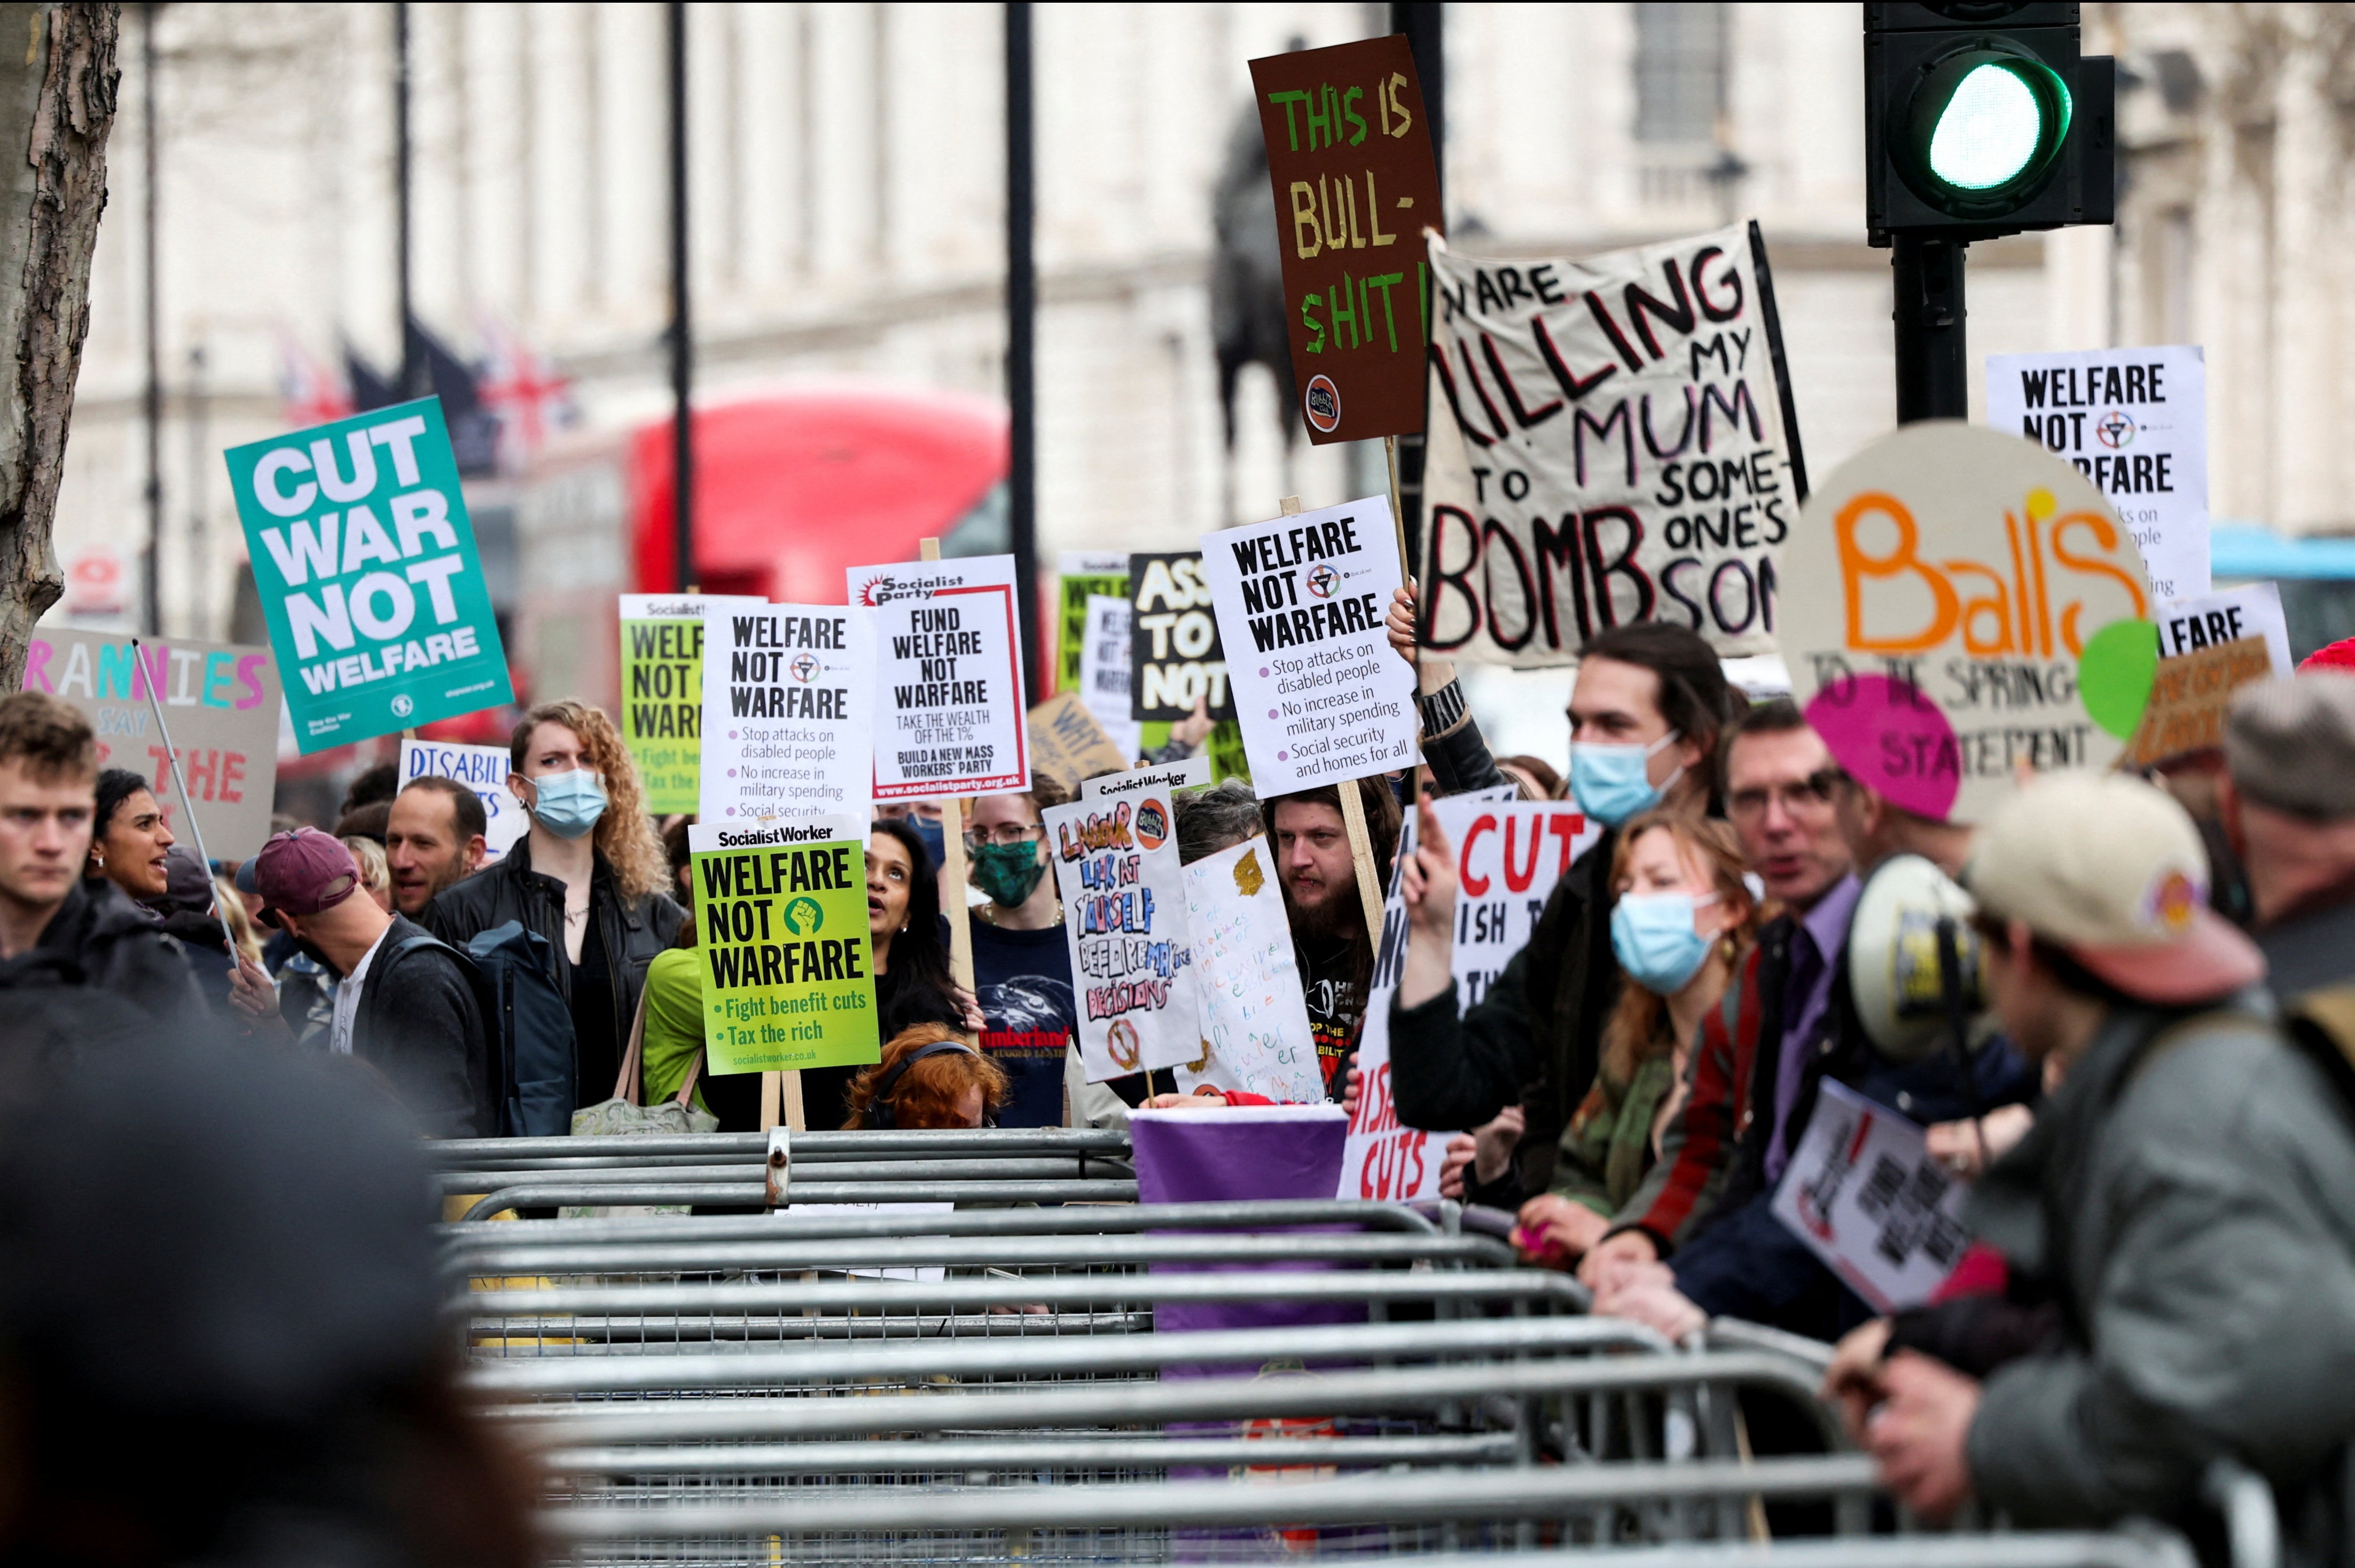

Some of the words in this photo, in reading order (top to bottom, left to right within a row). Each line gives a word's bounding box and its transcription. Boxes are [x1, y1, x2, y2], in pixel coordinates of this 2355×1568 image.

[1268, 82, 1367, 152] THIS
[1378, 72, 1412, 138] IS
[1290, 169, 1414, 260] BULL-
[1476, 265, 1565, 315] ARE
[1301, 270, 1403, 354] SHIT
[1690, 327, 1751, 381] MY
[2021, 364, 2165, 409] WELFARE
[1574, 379, 1763, 488] MUM
[2023, 412, 2087, 452] NOT
[253, 415, 426, 518] CUT
[1472, 467, 1529, 504] TO
[1664, 499, 1788, 550] ONE'S
[2138, 509, 2158, 523] on
[259, 490, 459, 587] WAR
[1231, 517, 1362, 576] WELFARE
[881, 576, 964, 592] Socialist
[1241, 570, 1298, 615] NOT
[1418, 504, 1655, 652] BOMB
[284, 554, 465, 661] NOT
[911, 607, 960, 633] FUND
[1248, 593, 1383, 653] WARFARE
[732, 616, 846, 649] WELFARE
[893, 631, 982, 660] WELFARE
[1139, 610, 1214, 660] TO
[300, 626, 480, 695] WELFARE
[731, 652, 784, 683] NOT
[921, 657, 957, 683] NOT
[1272, 656, 1303, 676] Stop
[1306, 646, 1354, 668] attacks
[1357, 644, 1374, 656] on
[1278, 671, 1333, 695] disabled
[1336, 660, 1381, 687] people
[633, 665, 690, 699] NOT
[894, 680, 988, 709] WARFARE
[1143, 660, 1229, 711] NOT
[730, 687, 848, 719] WARFARE
[1282, 701, 1302, 718] No
[1305, 692, 1359, 712] increase
[1362, 686, 1374, 699] in
[1287, 714, 1335, 736] military
[1340, 701, 1401, 727] spending
[97, 708, 149, 737] SAY
[632, 704, 701, 739] WAR
[742, 727, 769, 743] Stop
[772, 728, 816, 742] attacks
[818, 732, 834, 742] on
[897, 715, 924, 730] TAKE
[926, 712, 945, 727] THE
[946, 710, 990, 726] WEALTH
[914, 729, 934, 744] OFF
[935, 727, 954, 742] THE
[957, 726, 974, 741] 1%
[741, 744, 791, 759] disabled
[795, 745, 835, 762] people
[898, 749, 928, 764] BUILD
[930, 749, 937, 762] A
[939, 748, 962, 761] NEW
[966, 745, 993, 759] MASS
[1291, 737, 1332, 759] Social
[1334, 728, 1385, 750] security
[1296, 762, 1321, 778] and
[1323, 753, 1368, 772] homes
[1370, 747, 1389, 762] for
[1392, 740, 1408, 756] all
[148, 745, 246, 803] THE
[741, 766, 758, 779] No
[761, 766, 810, 780] increase
[813, 768, 825, 780] in
[877, 775, 1020, 796] www.socialistparty.org.uk
[902, 762, 957, 778] WORKERS'
[959, 759, 991, 773] PARTY
[740, 783, 784, 799] military
[788, 785, 843, 801] spending
[740, 803, 775, 817] Social
[1120, 854, 1140, 886] AT
[1460, 813, 1584, 897] CUT
[701, 848, 852, 899] WELFARE
[707, 899, 773, 944] NOT
[1075, 888, 1155, 940] YOURSELF
[709, 938, 864, 989] WARFARE
[725, 997, 765, 1022] Fight
[770, 992, 827, 1016] benefit
[833, 990, 866, 1010] cuts
[727, 1025, 756, 1046] Tax
[761, 1024, 785, 1042] the
[792, 1020, 823, 1040] rich
[1326, 1024, 1344, 1037] THE
[733, 1050, 816, 1065] socialistworker.co.uk
[1360, 1130, 1428, 1202] CUTS
